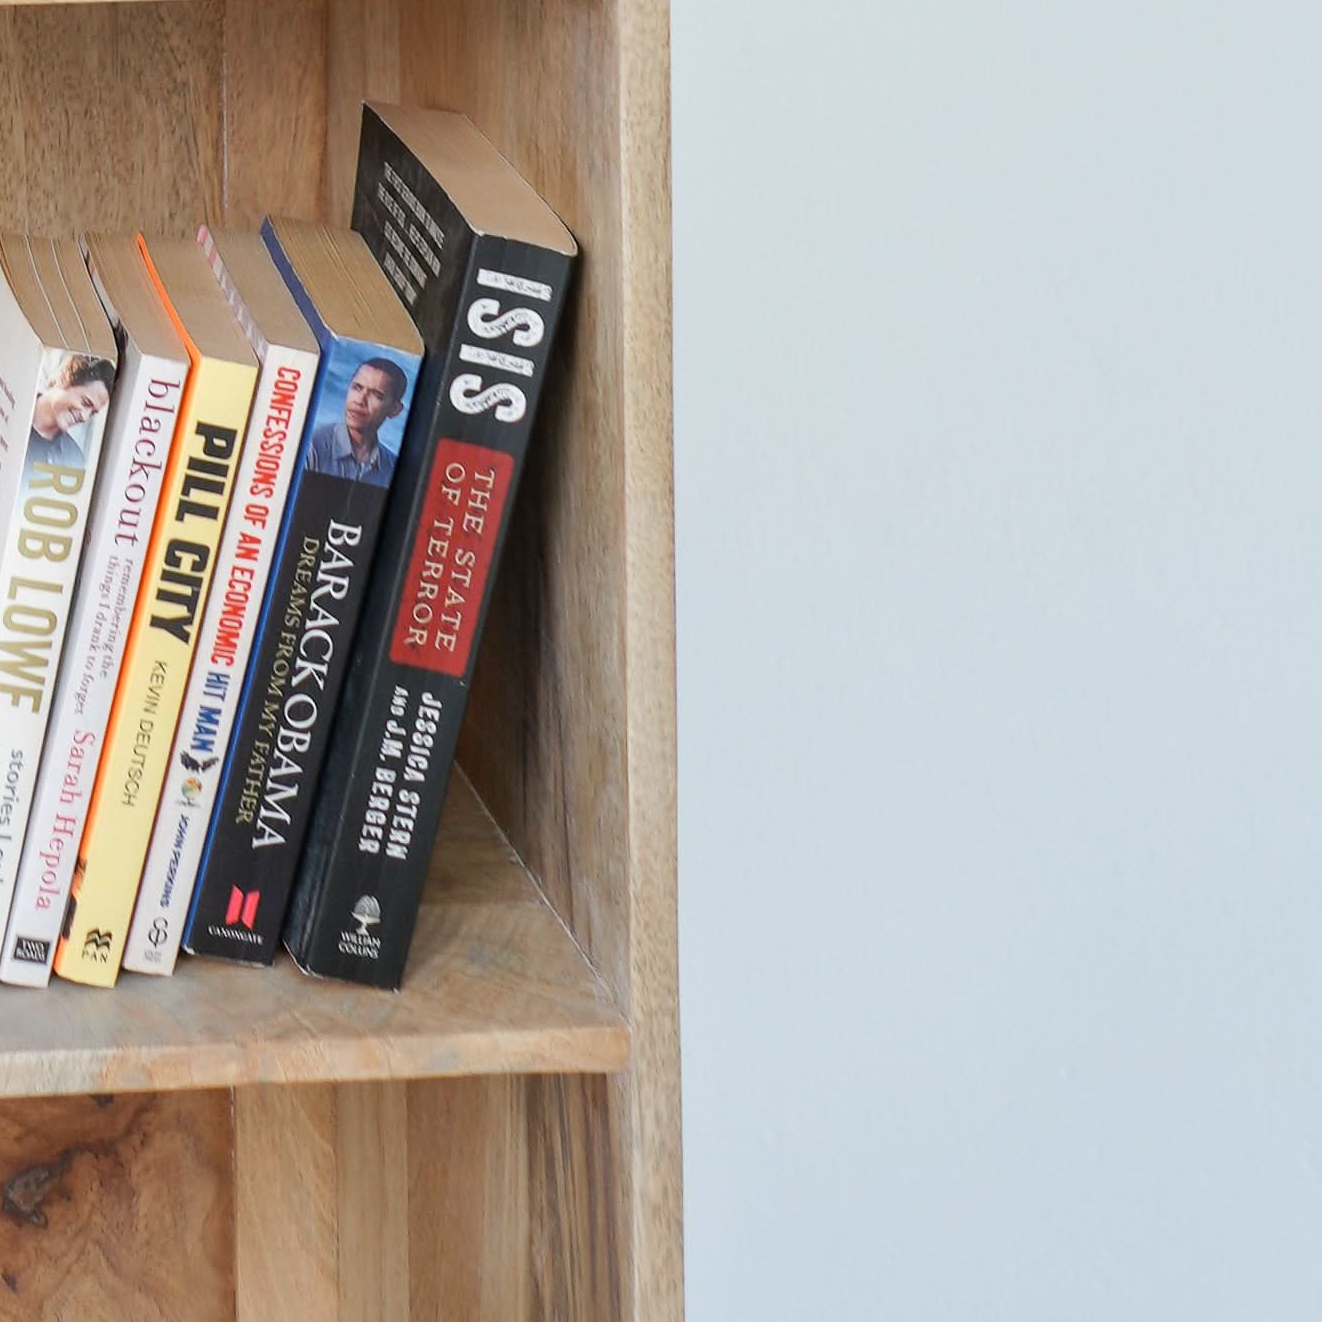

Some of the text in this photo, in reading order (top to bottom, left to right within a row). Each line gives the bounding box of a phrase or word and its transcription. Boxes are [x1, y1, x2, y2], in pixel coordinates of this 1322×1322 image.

[449, 267, 554, 423] ISIS
[17, 461, 86, 563] ROB
[114, 377, 181, 548] blackout
[149, 421, 238, 645] PILL CITY
[88, 611, 108, 653] drank
[99, 555, 118, 598] things
[100, 557, 134, 679] remembering the
[190, 366, 301, 754] CONFESSIONS OF AN ECONOMIC HIT MAN
[403, 462, 466, 646] OF TERROR
[435, 469, 496, 652] THE STATE
[74, 676, 95, 716] forget
[122, 660, 168, 807] KEVIN DEUTSCH
[235, 535, 320, 825] DREAMS FROM MY FATHER
[252, 518, 362, 850] BARACK OBAMA
[390, 685, 409, 716] AND
[35, 729, 96, 911] Sarah Hepola
[358, 767, 397, 855] BERGER
[385, 691, 443, 860] JESSICA STERN
[81, 949, 109, 964] PAN
